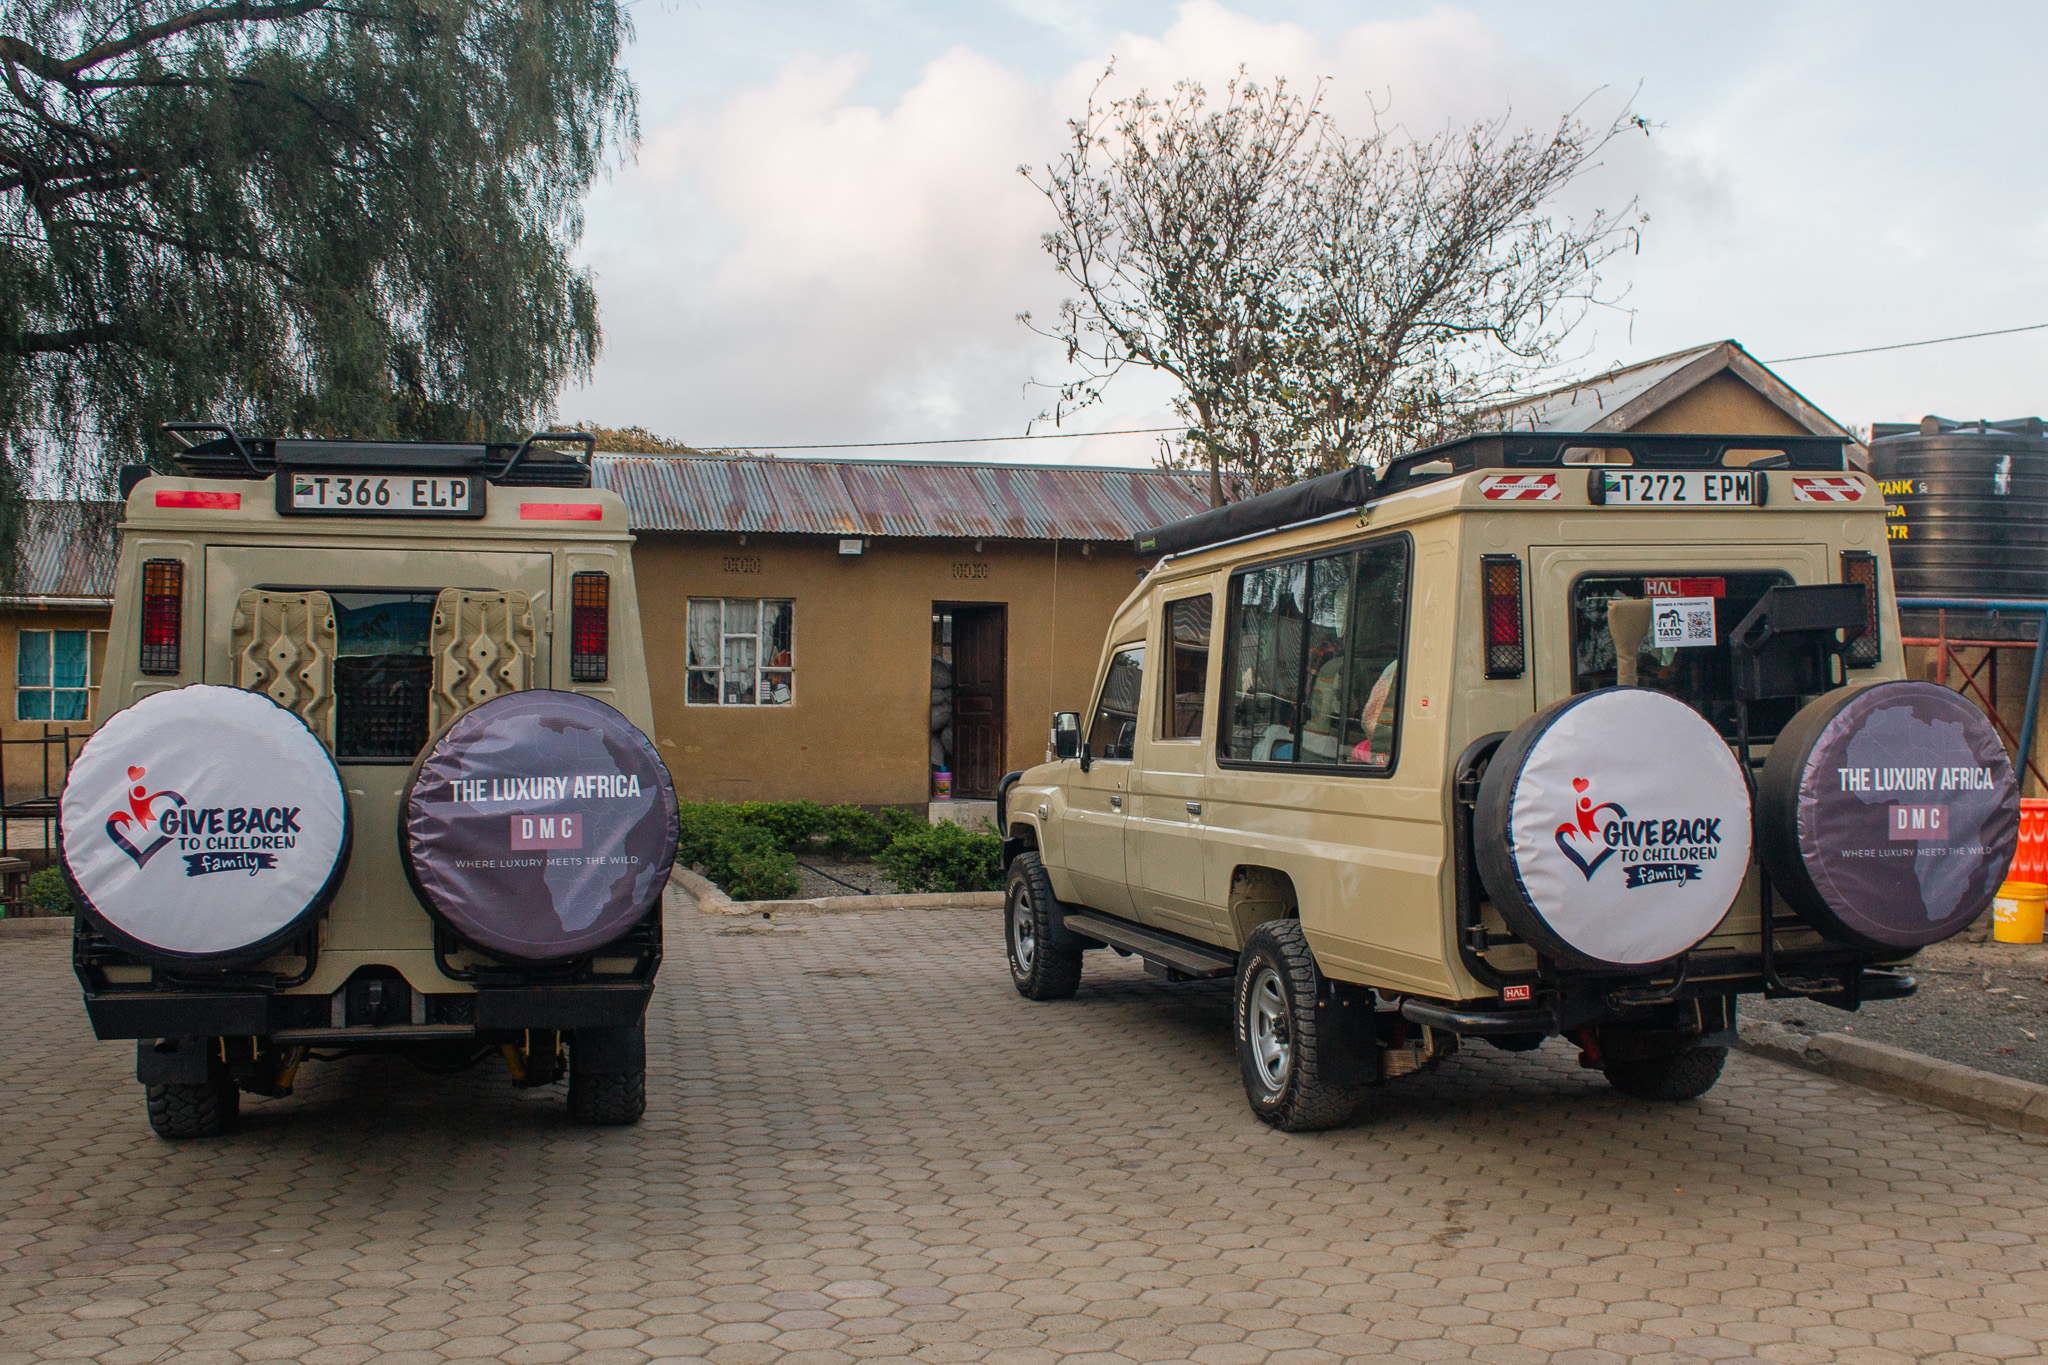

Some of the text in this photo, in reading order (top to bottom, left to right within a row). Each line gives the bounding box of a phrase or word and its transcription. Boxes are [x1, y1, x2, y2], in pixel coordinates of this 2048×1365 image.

[412, 479, 466, 507] ELP
[1704, 475, 1749, 501] EPM
[1657, 628, 1682, 636] TATO
[450, 774, 641, 802] THE LUXURY AFRICA
[1838, 767, 1994, 791] THE LUXURY AFRICA
[160, 807, 302, 835] GIVE BACK
[1603, 818, 1721, 847] GIVE BACK
[178, 836, 296, 850] TO CHILDREN
[1620, 846, 1718, 862] TO CHILDREN
[1841, 846, 1992, 858] WHERE LUXURY MEETS THE WILD
[201, 853, 260, 877] family
[455, 860, 496, 868] WHERE
[500, 858, 543, 868] LUXURY
[547, 857, 583, 866] MEETS
[586, 857, 606, 865] THE
[1638, 864, 1687, 888] family
